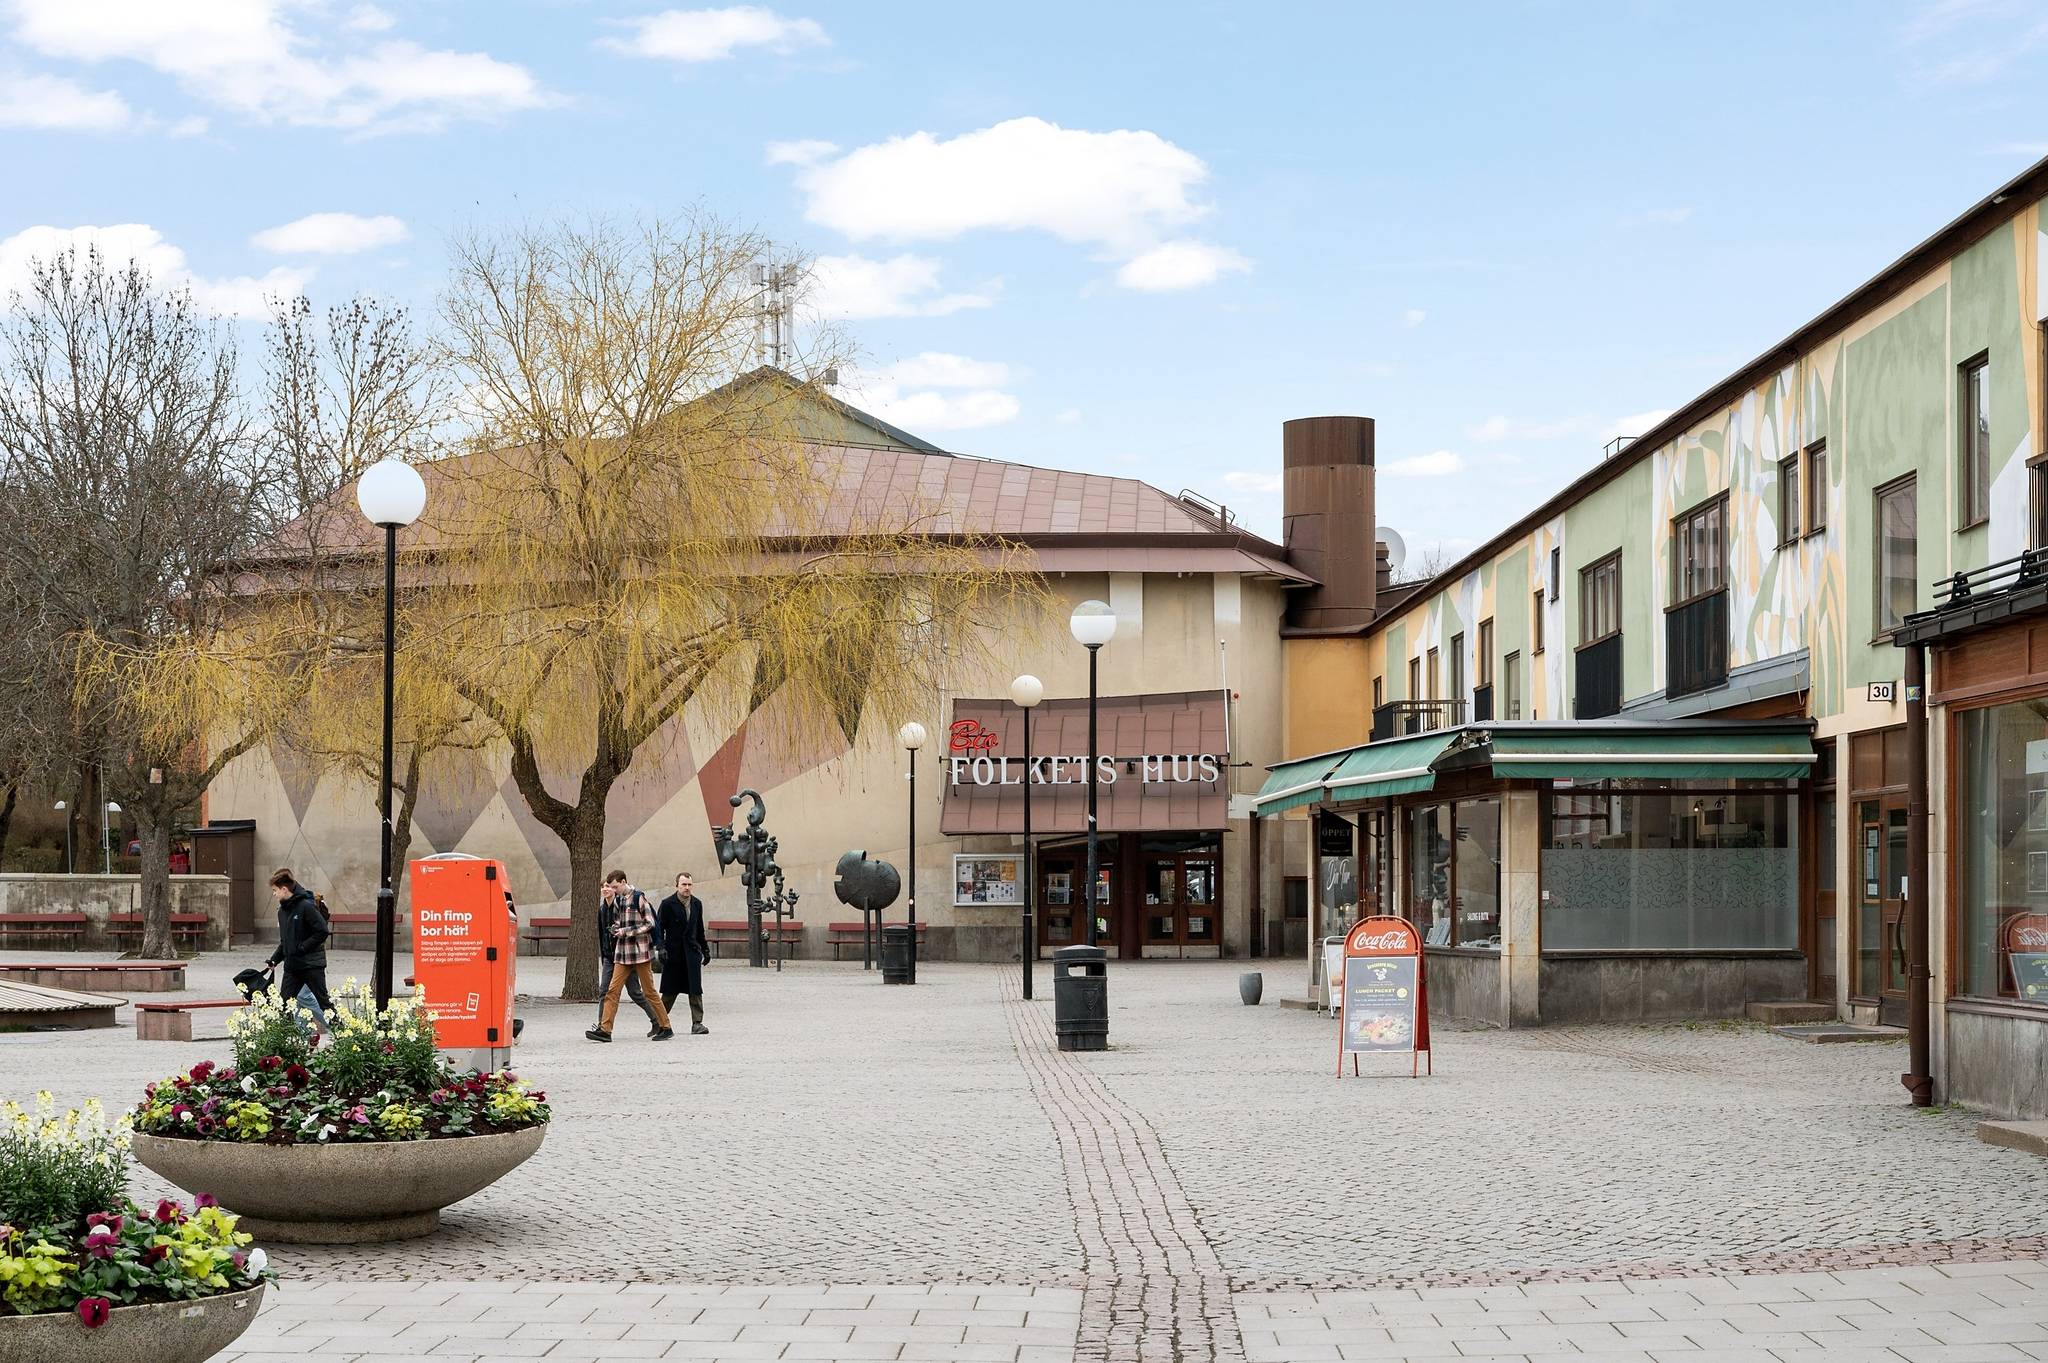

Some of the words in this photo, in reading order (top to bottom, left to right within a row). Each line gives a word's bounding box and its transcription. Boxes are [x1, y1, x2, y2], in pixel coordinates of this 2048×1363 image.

[1873, 686, 1889, 698] 30
[949, 719, 999, 752] Bio
[950, 755, 1117, 786] FOLKETS
[1141, 753, 1219, 784] HUS
[421, 910, 441, 921] Din
[444, 910, 473, 923] fimp
[421, 925, 442, 936] bor
[444, 925, 469, 936] här!
[1353, 930, 1409, 951] Coca-Cola
